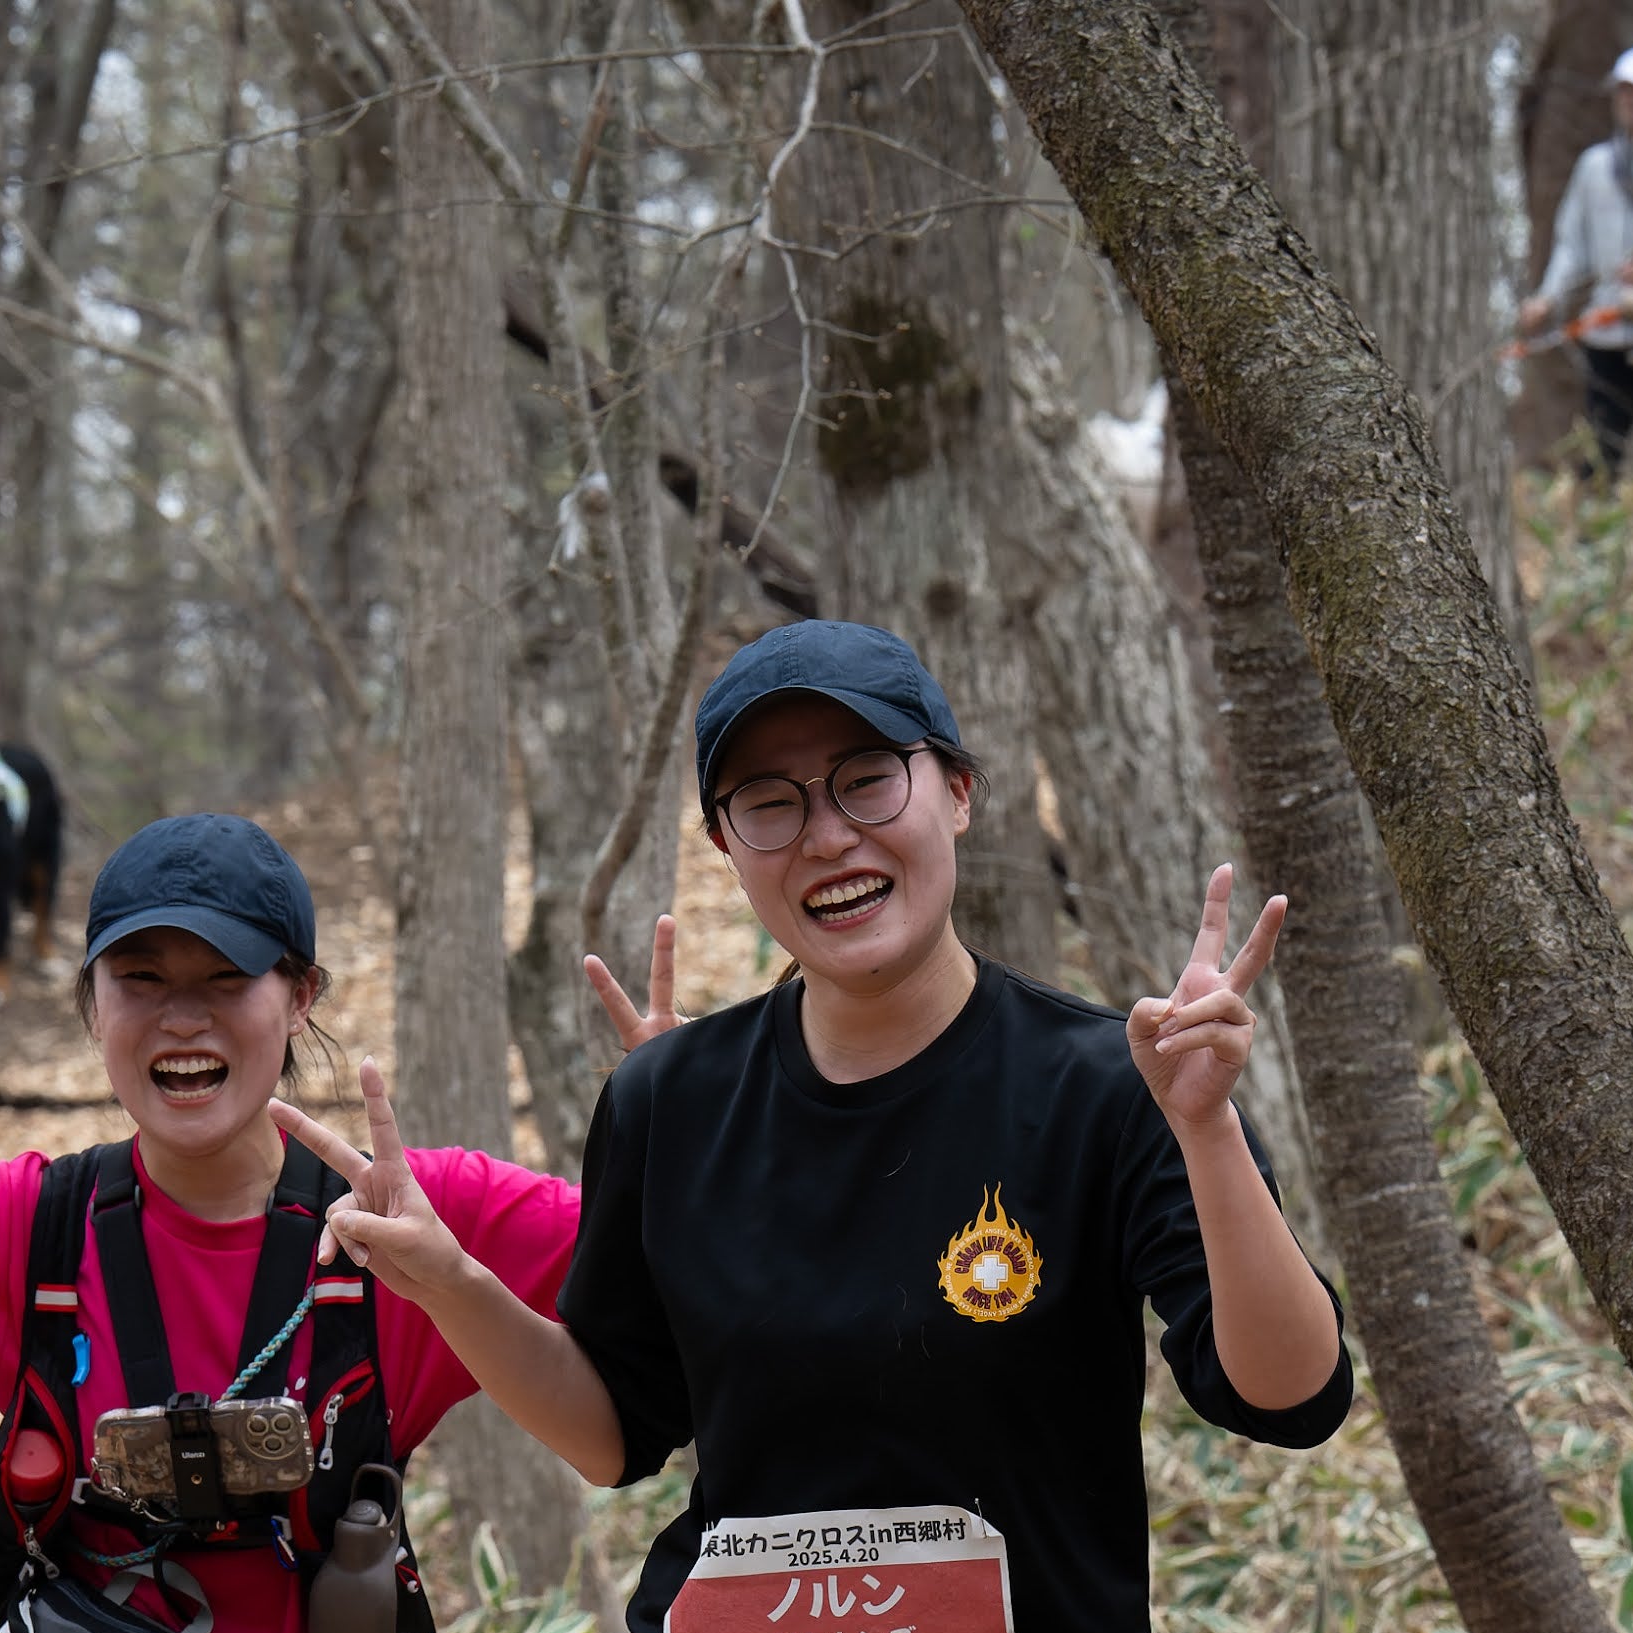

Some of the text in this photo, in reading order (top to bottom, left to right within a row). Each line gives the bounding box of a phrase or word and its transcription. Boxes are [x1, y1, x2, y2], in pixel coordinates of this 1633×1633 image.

[981, 1236, 1005, 1252] LIFE
[788, 1547, 880, 1567] 2025.4.20
[767, 1573, 906, 1623] ノルン
